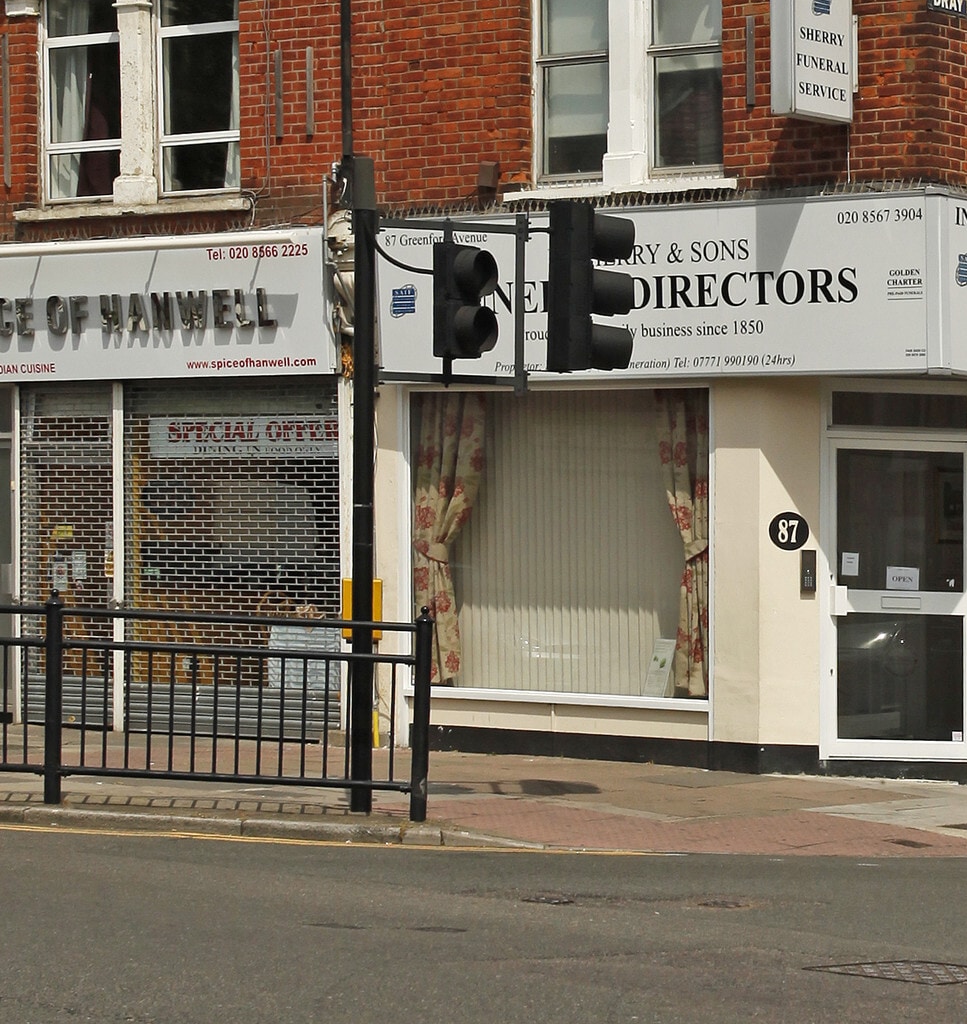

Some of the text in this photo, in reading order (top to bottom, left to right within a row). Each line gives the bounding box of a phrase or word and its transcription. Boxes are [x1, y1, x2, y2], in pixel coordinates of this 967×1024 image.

[799, 26, 845, 47] SHERRY
[796, 54, 849, 75] FUNERAL
[798, 81, 847, 102] SERVICE
[837, 207, 923, 224] 020 8567 3904
[384, 232, 488, 246] 87 Greenfor Avenue
[206, 243, 308, 260] Tel: 020 8566 2225
[666, 242, 684, 264] &
[690, 239, 750, 263] SONS
[889, 268, 920, 277] GOLDEN
[631, 267, 859, 310] DIRECTORS
[886, 278, 923, 286] CHARTER
[46, 295, 89, 336] OF
[99, 287, 278, 334] HANWELL
[641, 323, 693, 337] business
[696, 321, 728, 336] since
[733, 320, 764, 335] 1850
[20, 363, 56, 374] CUISINE
[186, 357, 317, 371] www.spiceofhanwell.com
[674, 357, 690, 368] Tel:
[693, 356, 721, 367] 07771
[724, 355, 759, 366] 990190
[761, 354, 796, 367] (24hrs)
[167, 420, 259, 443] SPECIAL
[777, 519, 800, 543] 87
[891, 575, 914, 583] OPEN
